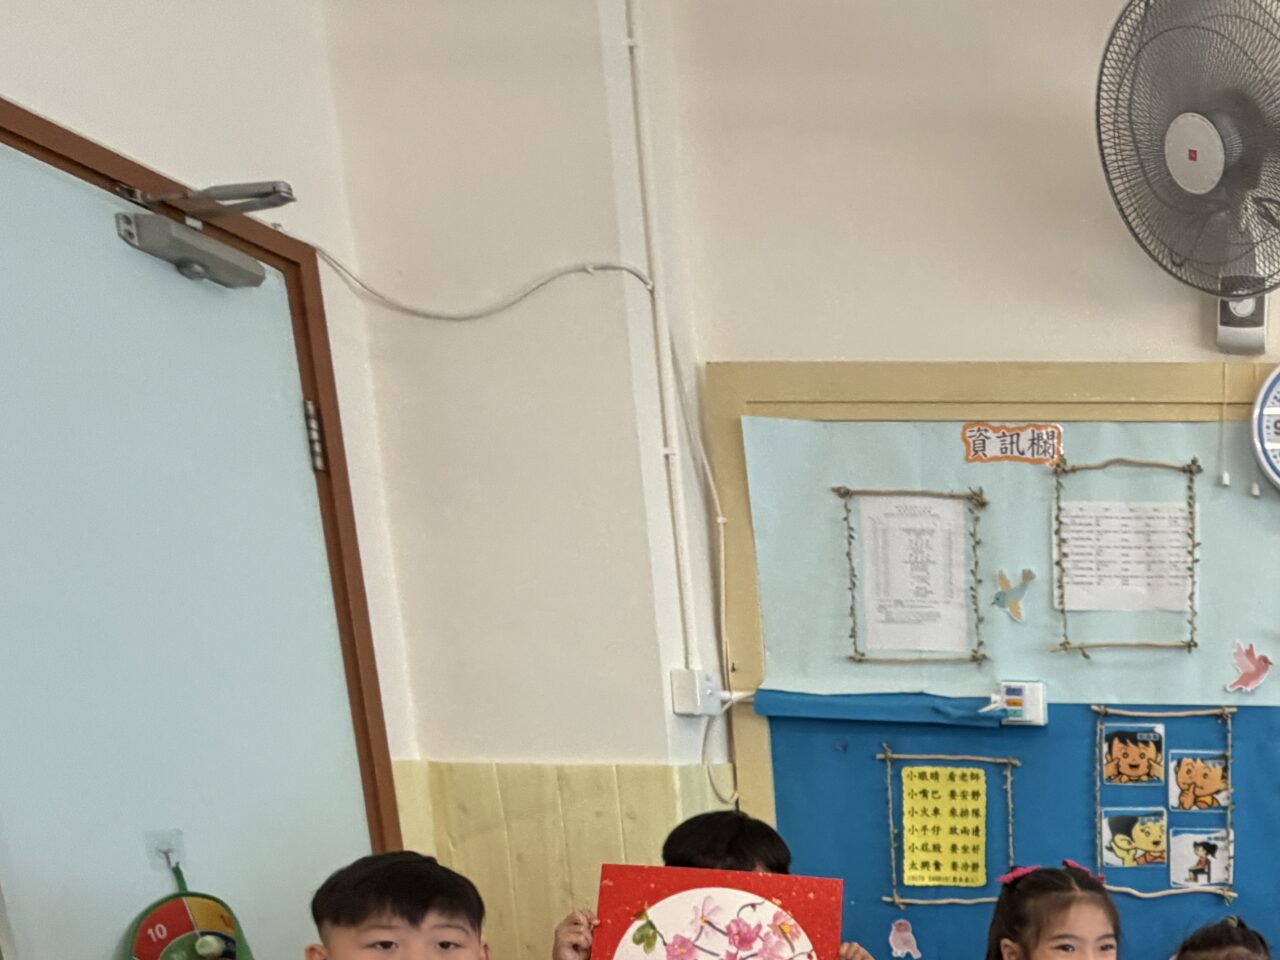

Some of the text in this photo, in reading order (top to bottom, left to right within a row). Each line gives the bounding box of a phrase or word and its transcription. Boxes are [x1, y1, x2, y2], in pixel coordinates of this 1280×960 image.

[967, 427, 1056, 459] 資訊欄
[907, 771, 940, 782] 小眼睛
[908, 789, 942, 800] 小嘴巴
[147, 923, 168, 942] 10
